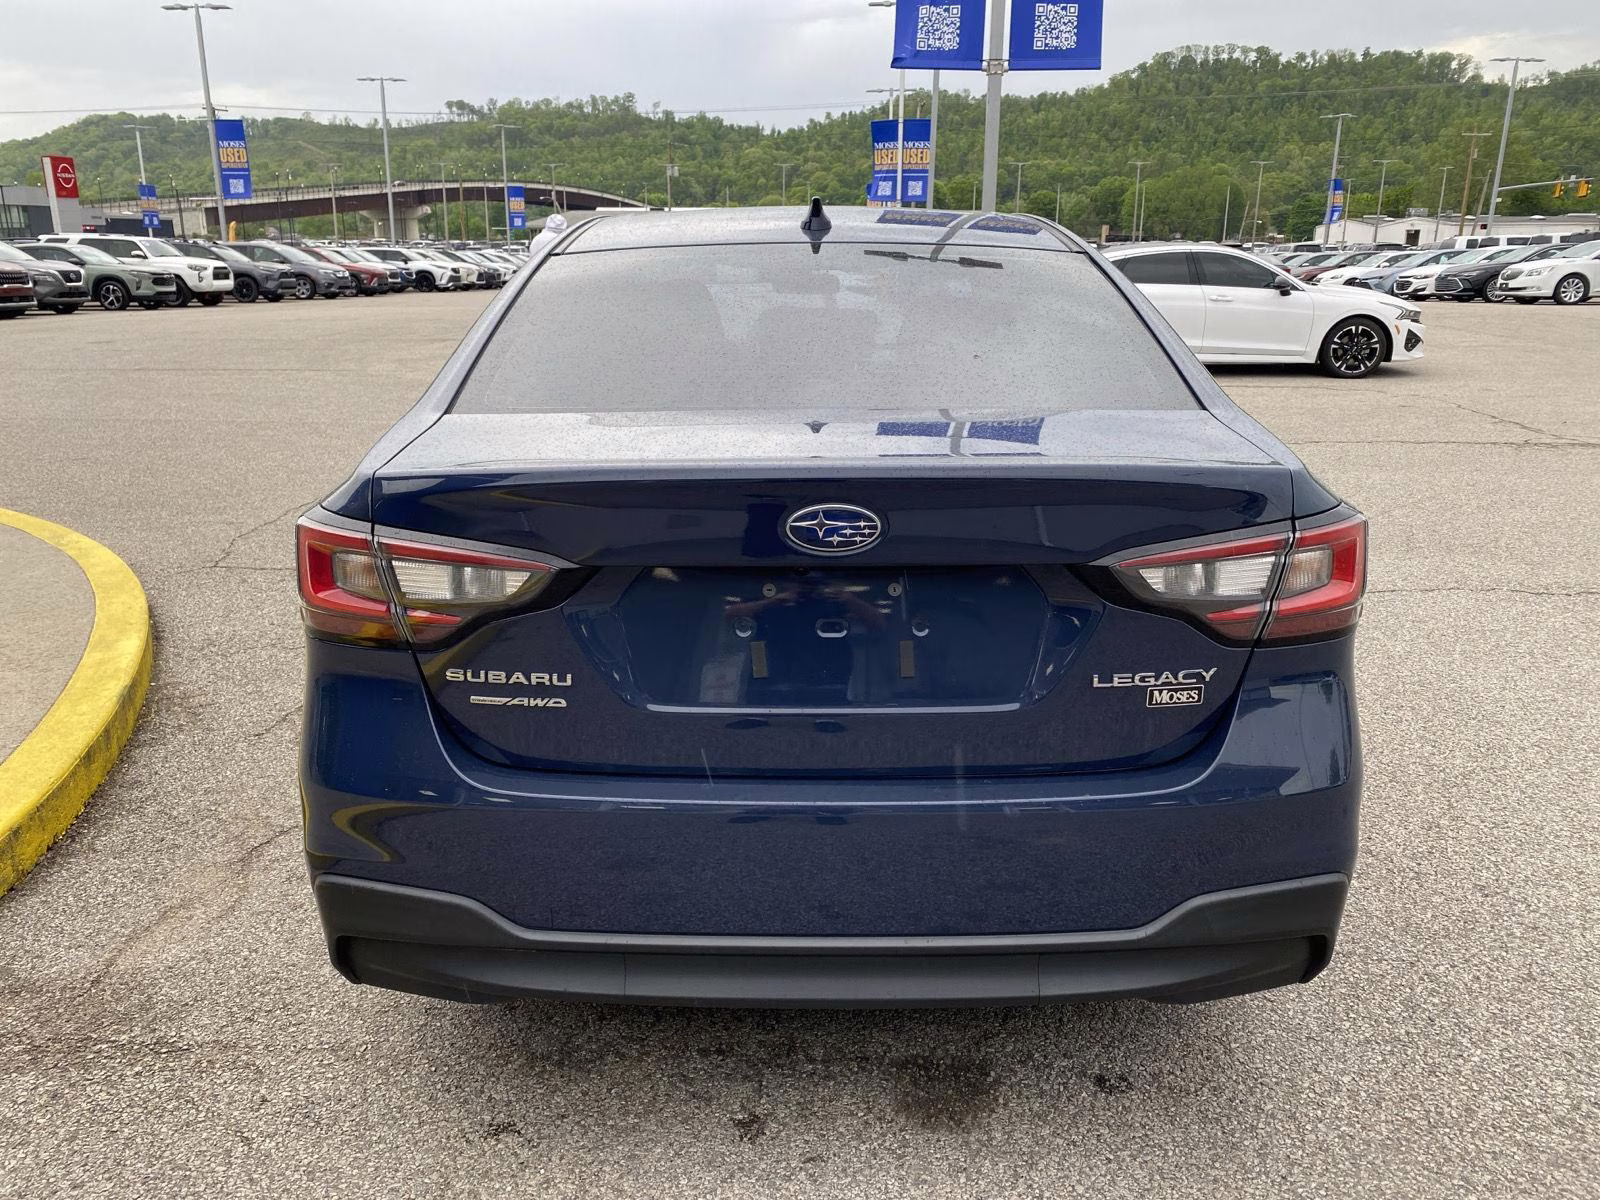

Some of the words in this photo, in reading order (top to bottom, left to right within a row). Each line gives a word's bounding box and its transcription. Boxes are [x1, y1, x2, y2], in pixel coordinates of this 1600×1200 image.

[219, 140, 246, 148] MOSES
[904, 141, 931, 149] MOSES
[219, 148, 248, 163] USED
[903, 148, 929, 164] USED
[445, 668, 572, 686] SUBARU
[1093, 667, 1218, 688] LEGACY
[506, 697, 567, 707] AWD
[1151, 689, 1199, 704] MOSES
